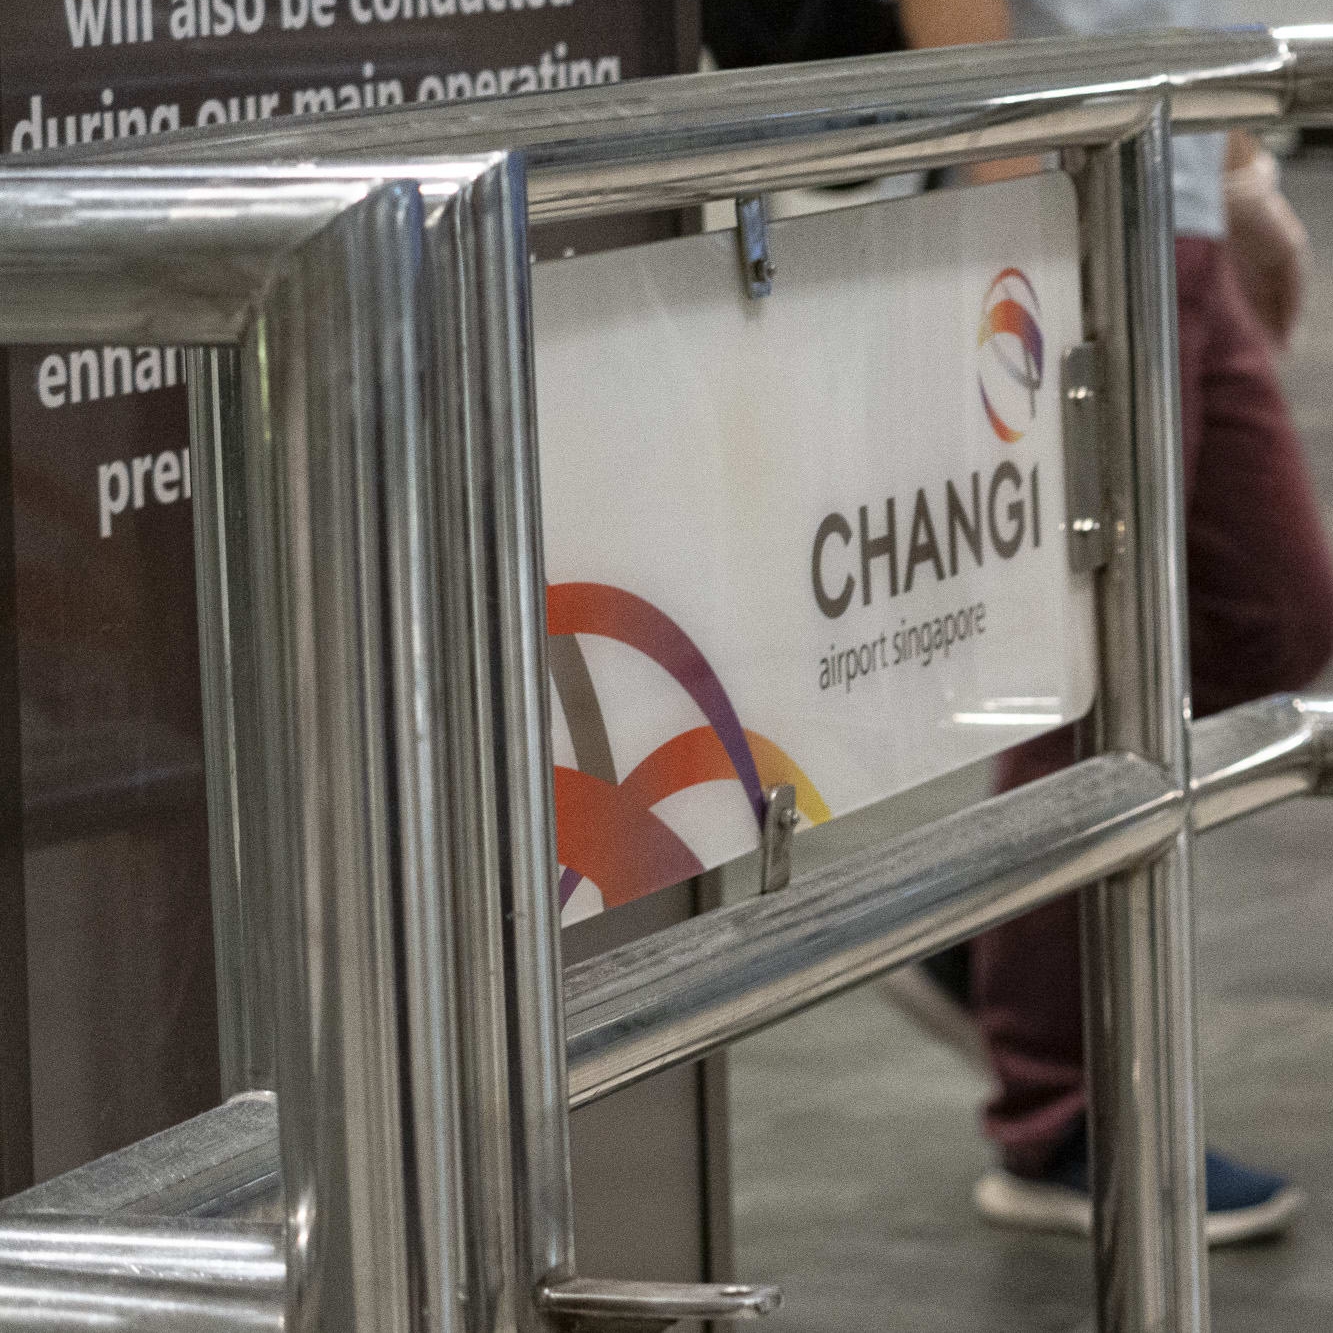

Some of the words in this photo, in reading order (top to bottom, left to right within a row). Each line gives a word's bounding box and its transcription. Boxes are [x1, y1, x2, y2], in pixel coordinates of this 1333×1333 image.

[811, 461, 1041, 618] CHANGI
[819, 630, 888, 694] airport
[893, 602, 986, 666] singapore
